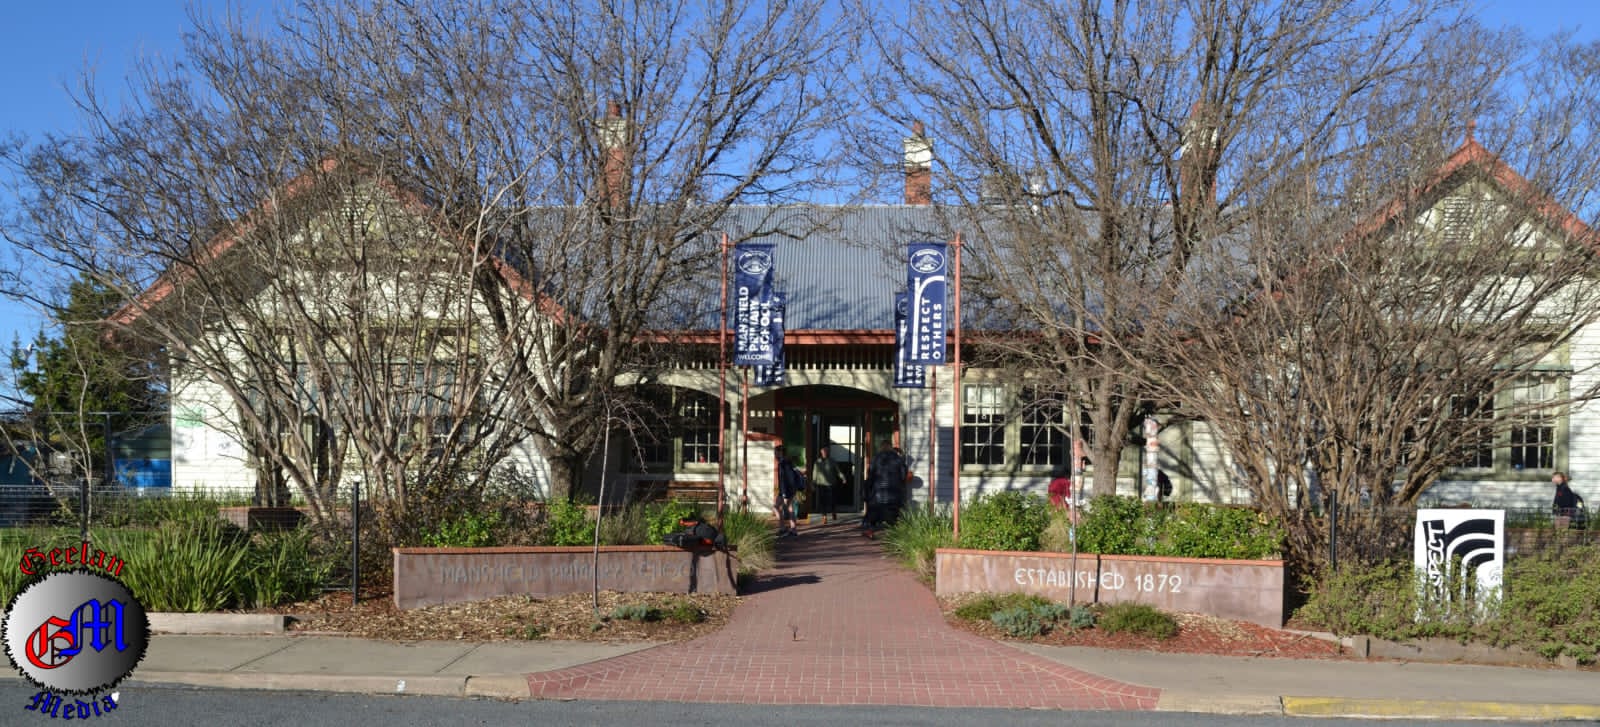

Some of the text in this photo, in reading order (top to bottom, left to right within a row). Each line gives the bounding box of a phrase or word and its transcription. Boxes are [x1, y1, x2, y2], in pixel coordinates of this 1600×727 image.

[760, 300, 771, 352] SCHOOL
[921, 298, 931, 360] RESPECT
[932, 303, 943, 360] OTHERS
[631, 560, 704, 582] SCHOO
[1014, 567, 1182, 594] ESTABLISHED 1872
